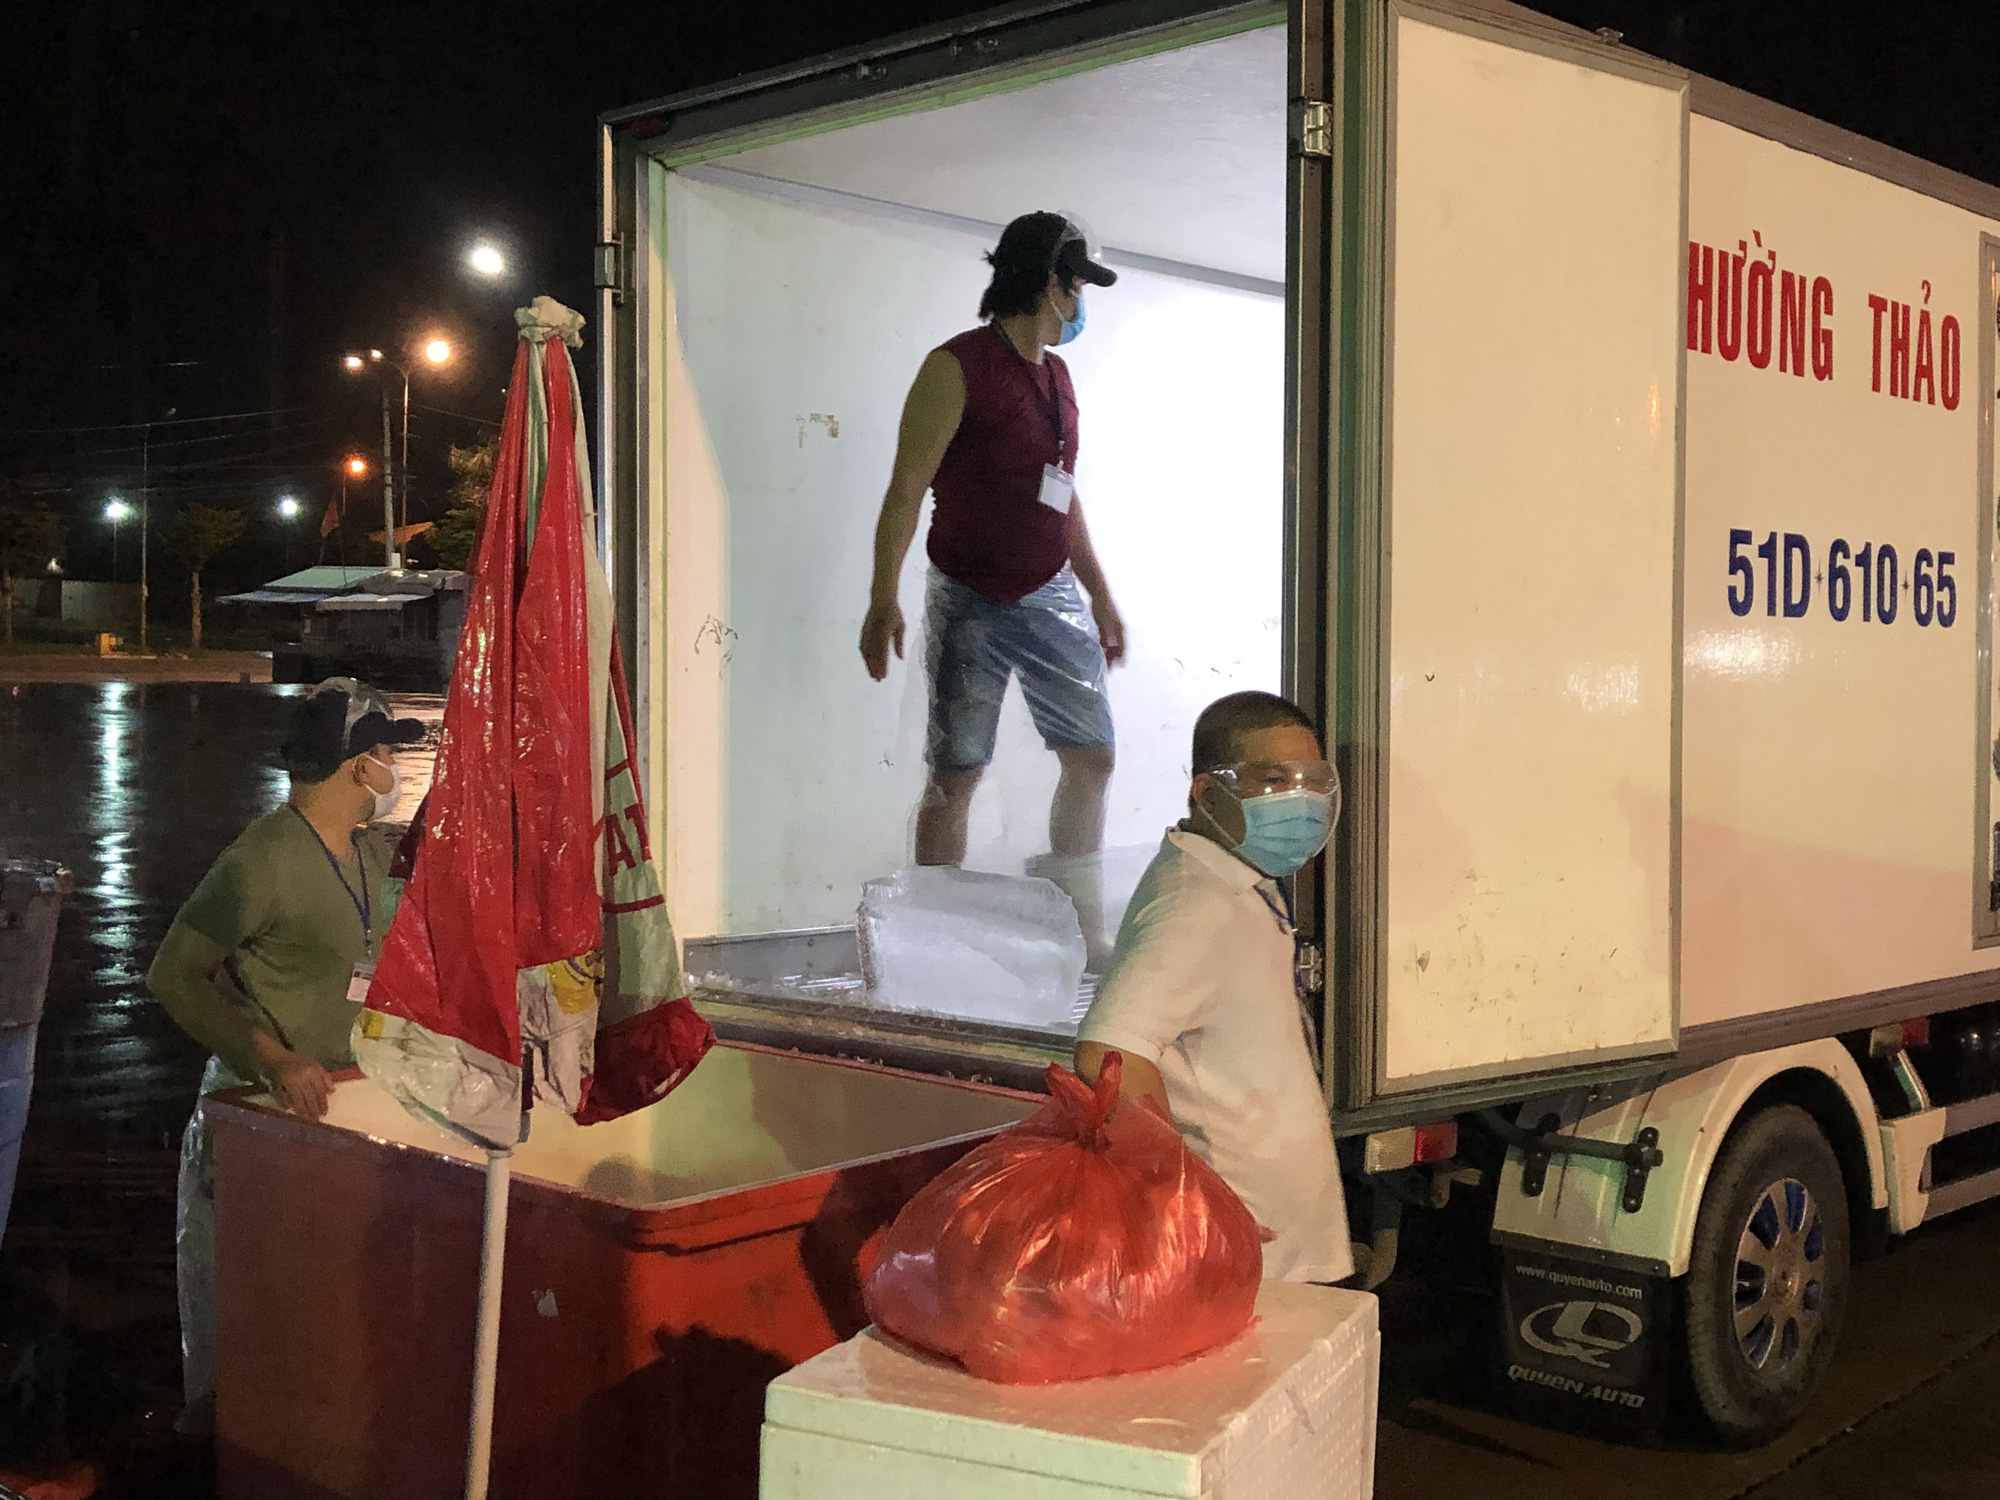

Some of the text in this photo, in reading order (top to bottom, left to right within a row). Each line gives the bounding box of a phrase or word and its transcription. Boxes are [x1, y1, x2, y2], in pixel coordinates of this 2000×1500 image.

[1868, 279, 1961, 411] THẢO
[1515, 1264, 1643, 1300] www.quyenauto.com
[1583, 1385, 1646, 1408] AUTO
